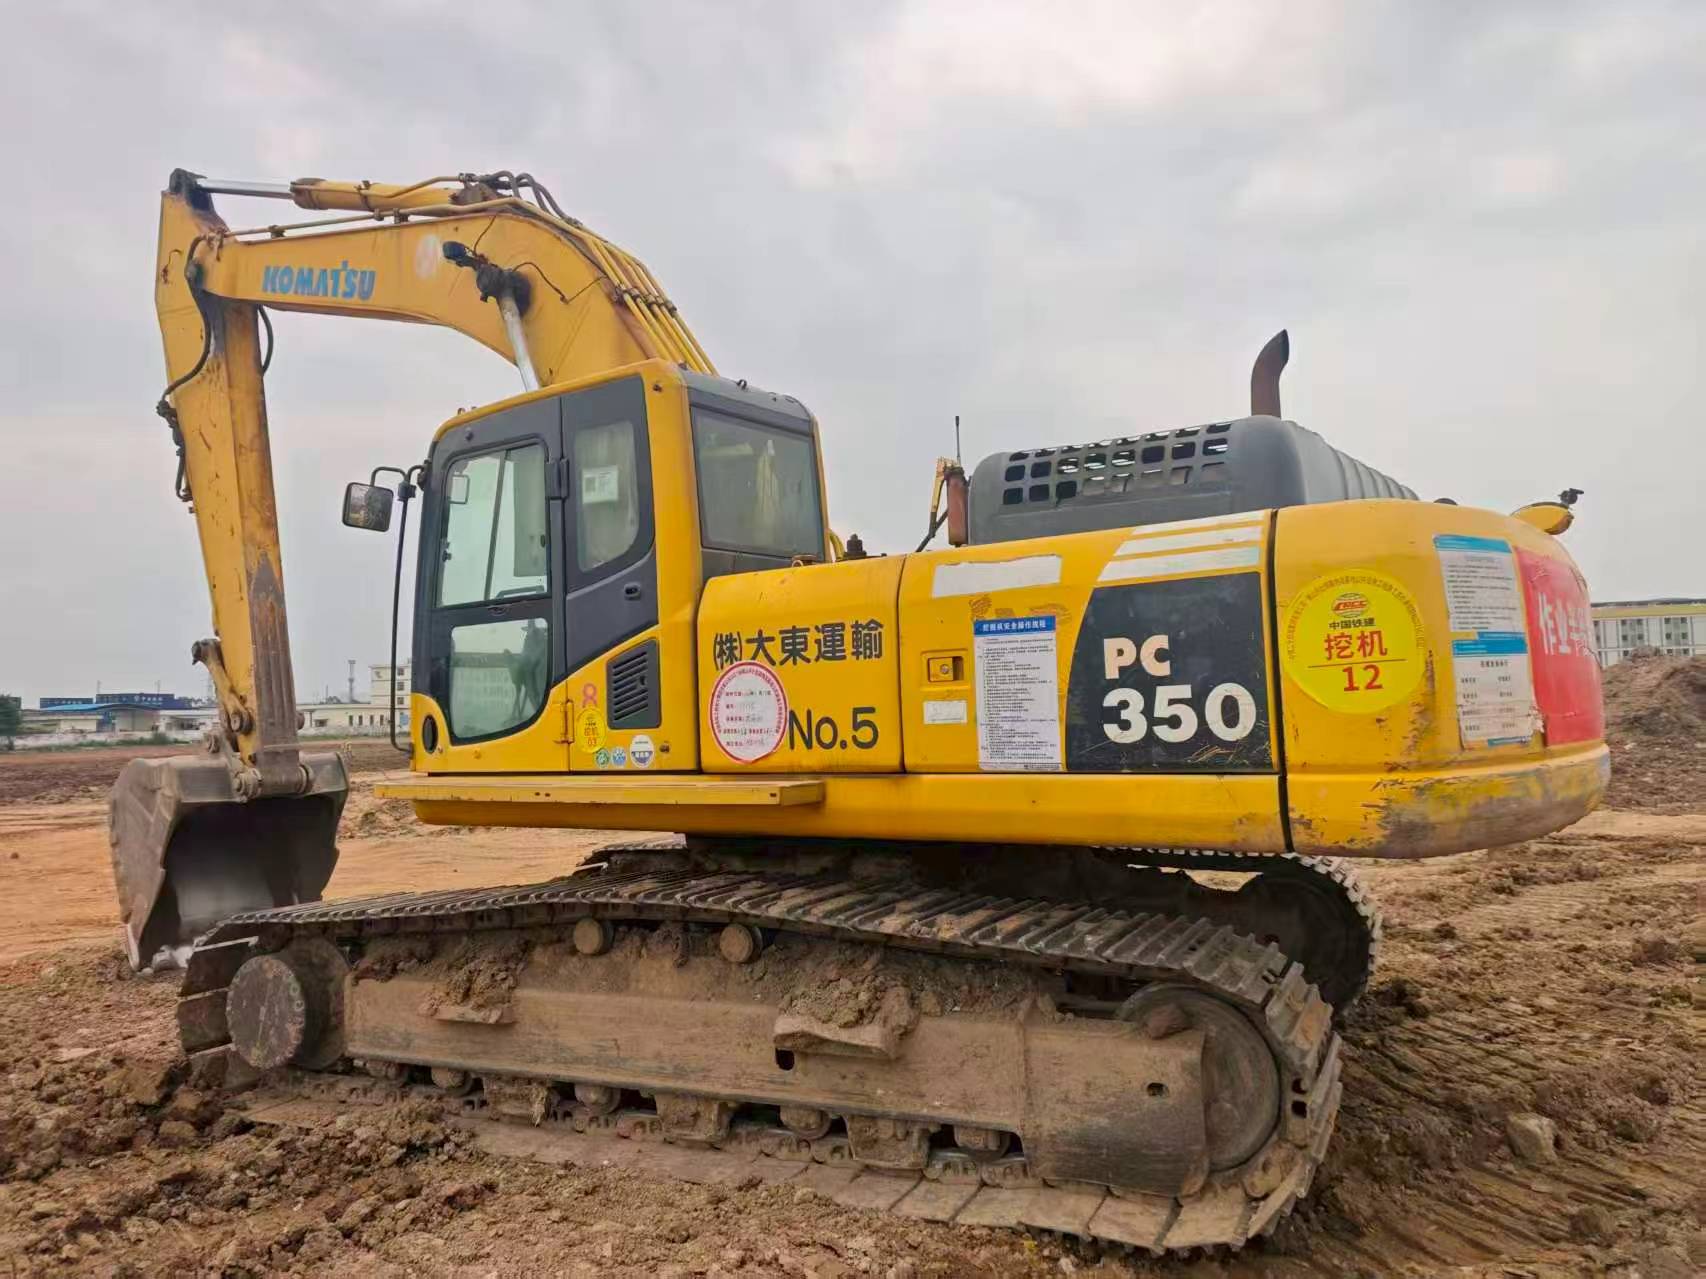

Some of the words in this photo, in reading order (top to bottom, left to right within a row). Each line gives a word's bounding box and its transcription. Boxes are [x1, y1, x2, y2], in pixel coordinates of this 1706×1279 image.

[262, 260, 377, 301] KOMATSU
[1329, 618, 1376, 630] 中国铁建
[1103, 635, 1170, 680] PC
[1324, 630, 1388, 660] 挖机
[1342, 664, 1384, 692] 12
[788, 706, 879, 750] No.5
[1102, 682, 1257, 743] 350
